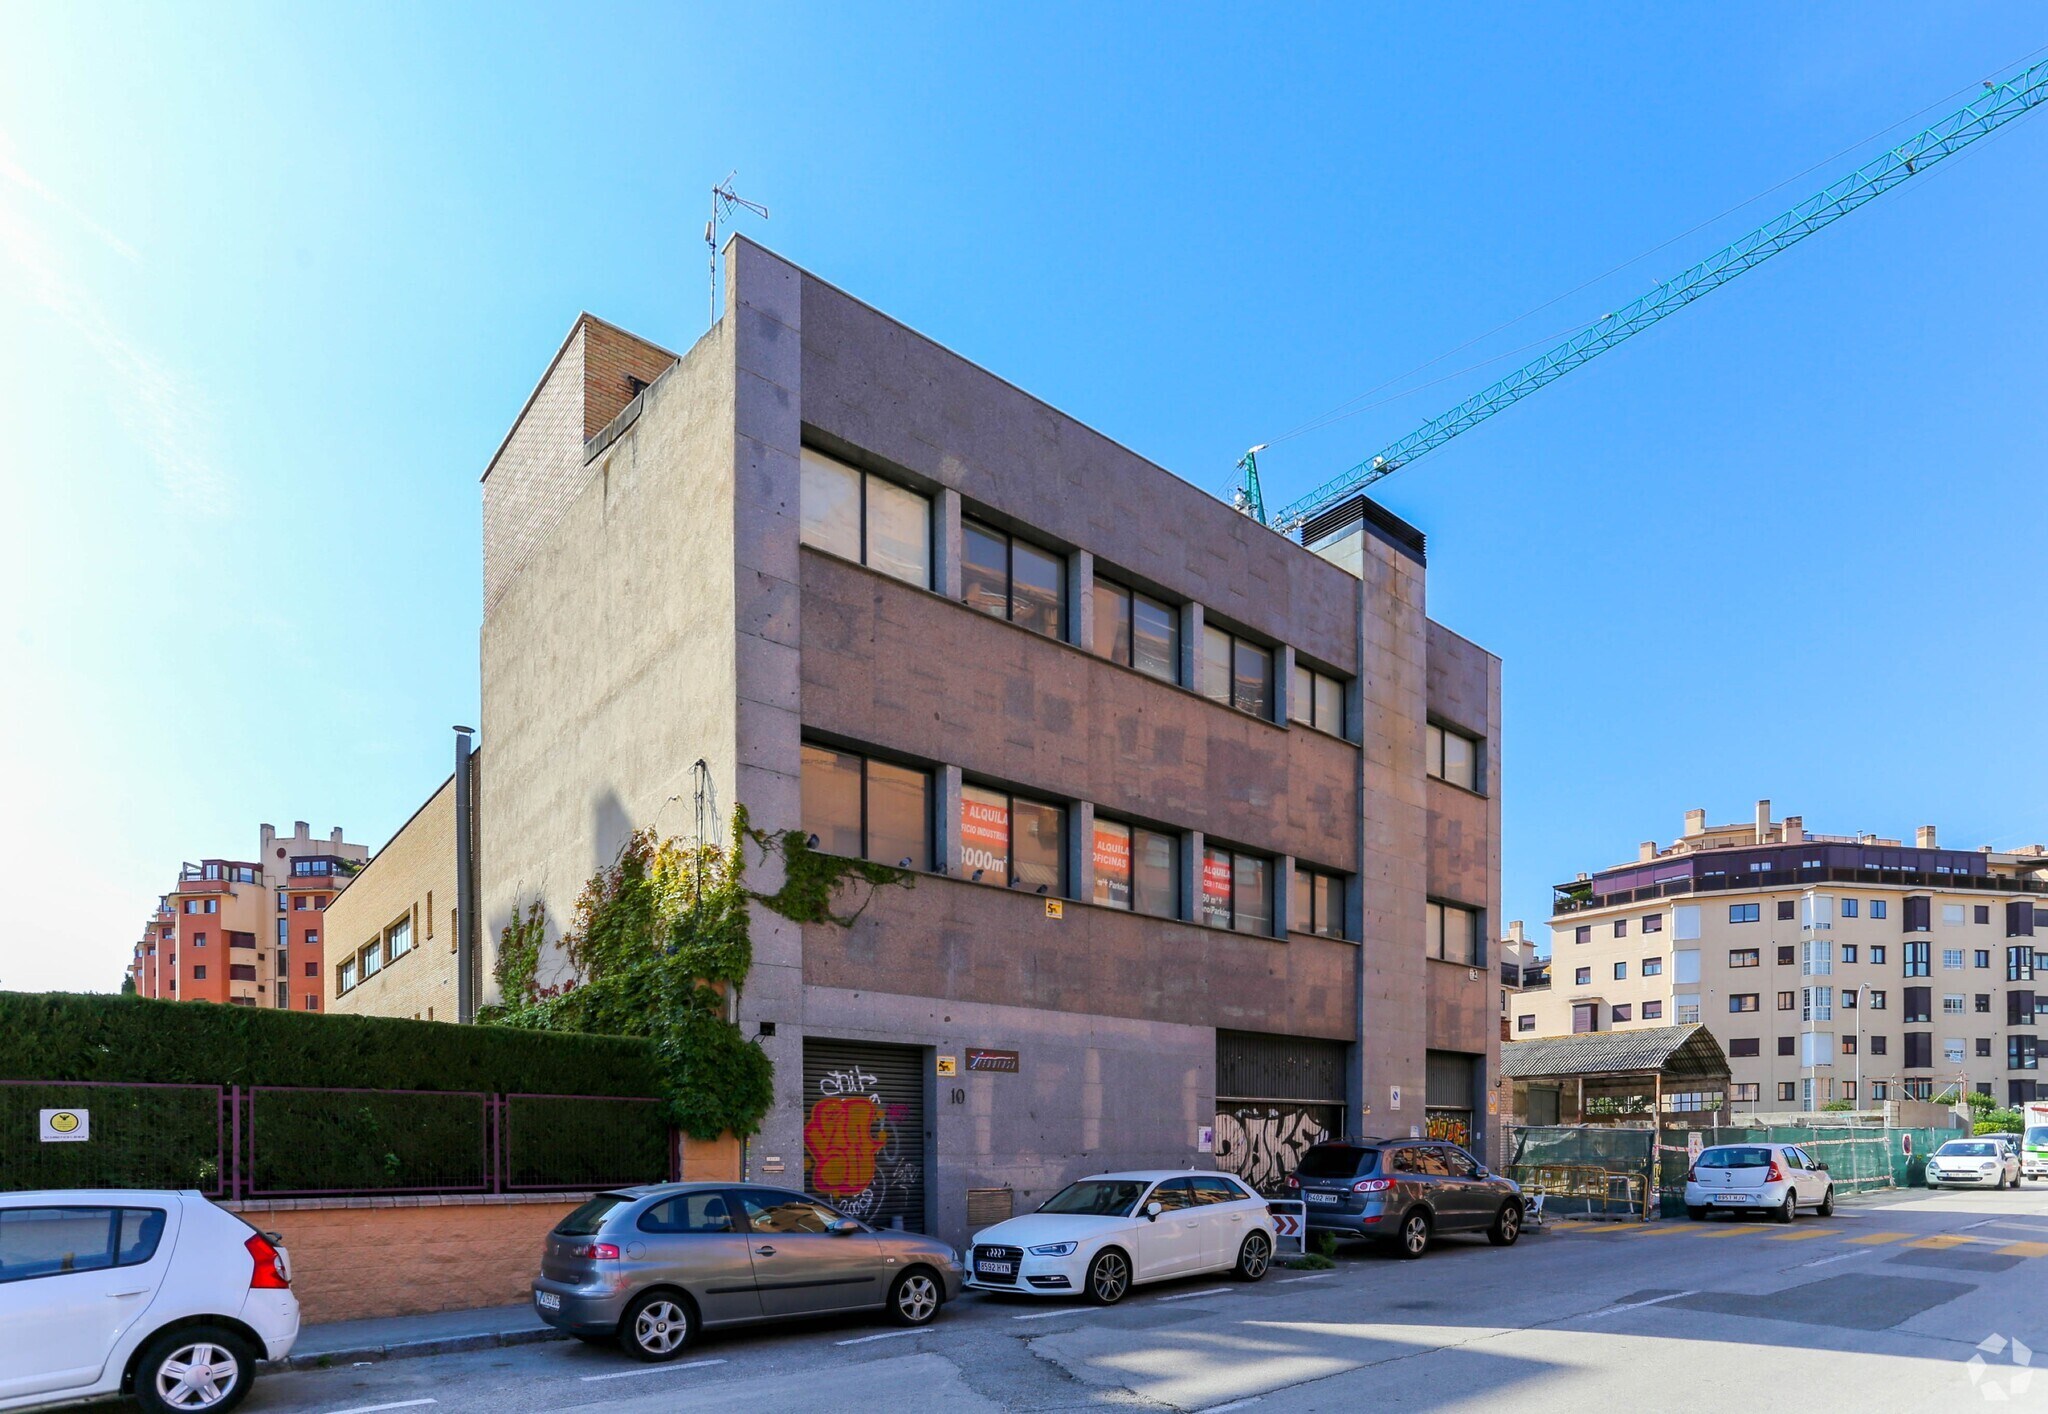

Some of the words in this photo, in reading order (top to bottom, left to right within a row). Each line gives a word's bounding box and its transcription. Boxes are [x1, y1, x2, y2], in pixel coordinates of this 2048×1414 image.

[969, 805, 1008, 826] ALQUILA
[977, 826, 1008, 842] INDUSTRIAL
[1097, 840, 1129, 856] ALQUILA
[1203, 865, 1230, 878] ALQUILA
[951, 1088, 965, 1105] 10
